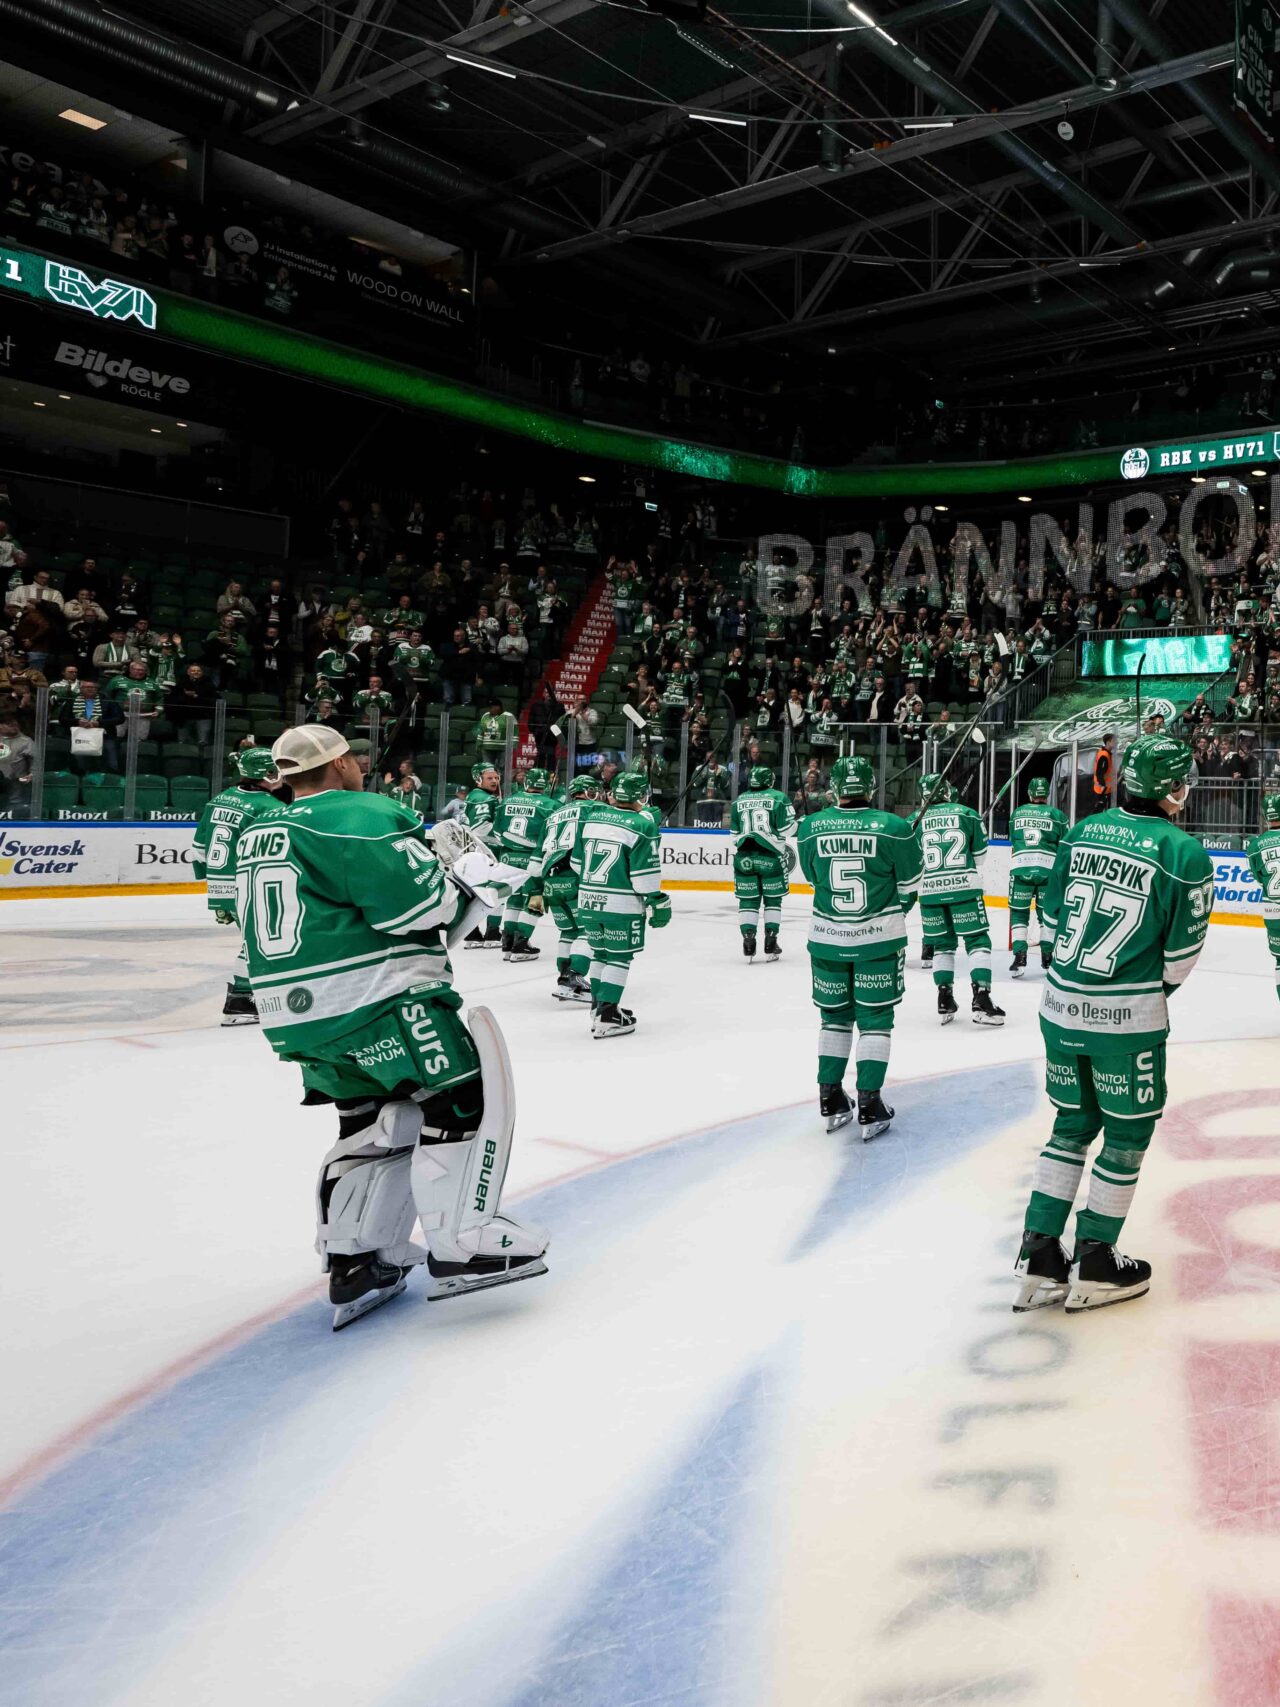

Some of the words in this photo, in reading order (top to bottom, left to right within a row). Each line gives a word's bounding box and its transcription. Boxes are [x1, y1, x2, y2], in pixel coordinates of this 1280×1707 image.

[345, 268, 398, 298] WOOD
[400, 289, 423, 308] ON
[425, 297, 465, 323] WALL
[54, 341, 192, 395] Bildeve
[120, 382, 162, 402] RÖGLE
[1160, 449, 1192, 468] RBK
[1198, 450, 1217, 463] vs
[1223, 440, 1265, 460] HV71
[582, 627, 607, 637] MAXI
[587, 619, 611, 629] MAXI
[573, 644, 599, 654] MAXI
[578, 636, 604, 646] MAXI
[569, 653, 595, 663] MAXI
[565, 662, 591, 672] MAXI
[560, 671, 587, 682] MAXI
[555, 680, 583, 691] MAXI
[59, 808, 109, 821] Boozt
[150, 809, 199, 822] Boozt
[474, 803, 490, 814] 22
[506, 806, 534, 816] SANDIN
[693, 819, 723, 829] Boozt
[740, 809, 771, 836] 18
[924, 818, 956, 831] HORKY
[2, 839, 87, 857] Svensk
[207, 825, 233, 869] 6
[819, 837, 874, 855] KUMLIN
[921, 829, 967, 871] 62
[1201, 837, 1232, 851] Boozt
[391, 836, 437, 870] 70
[14, 857, 79, 875] Cater
[582, 839, 623, 885] 17
[1071, 852, 1150, 892] SUNDSVIK
[829, 857, 868, 914] 5
[1053, 878, 1149, 978] 37
[854, 973, 892, 982] CERNITOL
[860, 981, 893, 990] NOVUM
[1082, 1002, 1132, 1025] Design
[473, 1139, 497, 1212] BAUER
